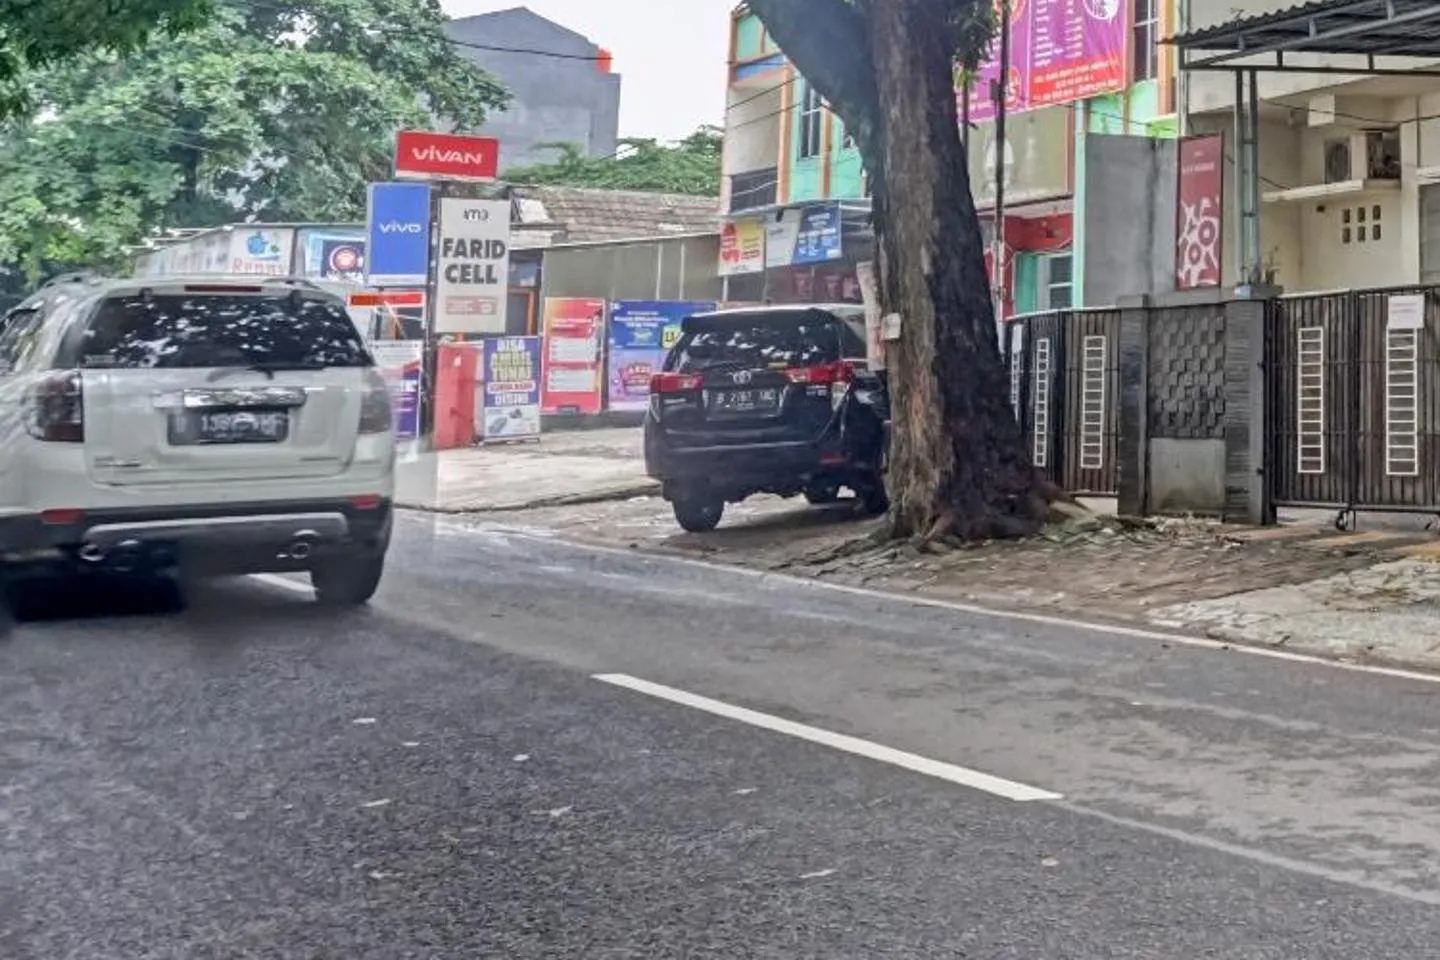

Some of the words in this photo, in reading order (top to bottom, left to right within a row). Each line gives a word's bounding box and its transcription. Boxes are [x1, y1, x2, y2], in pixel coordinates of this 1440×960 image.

[411, 144, 483, 165] VIVAN
[379, 220, 421, 233] vivo
[442, 238, 506, 259] FARID
[444, 264, 498, 284] CELL
